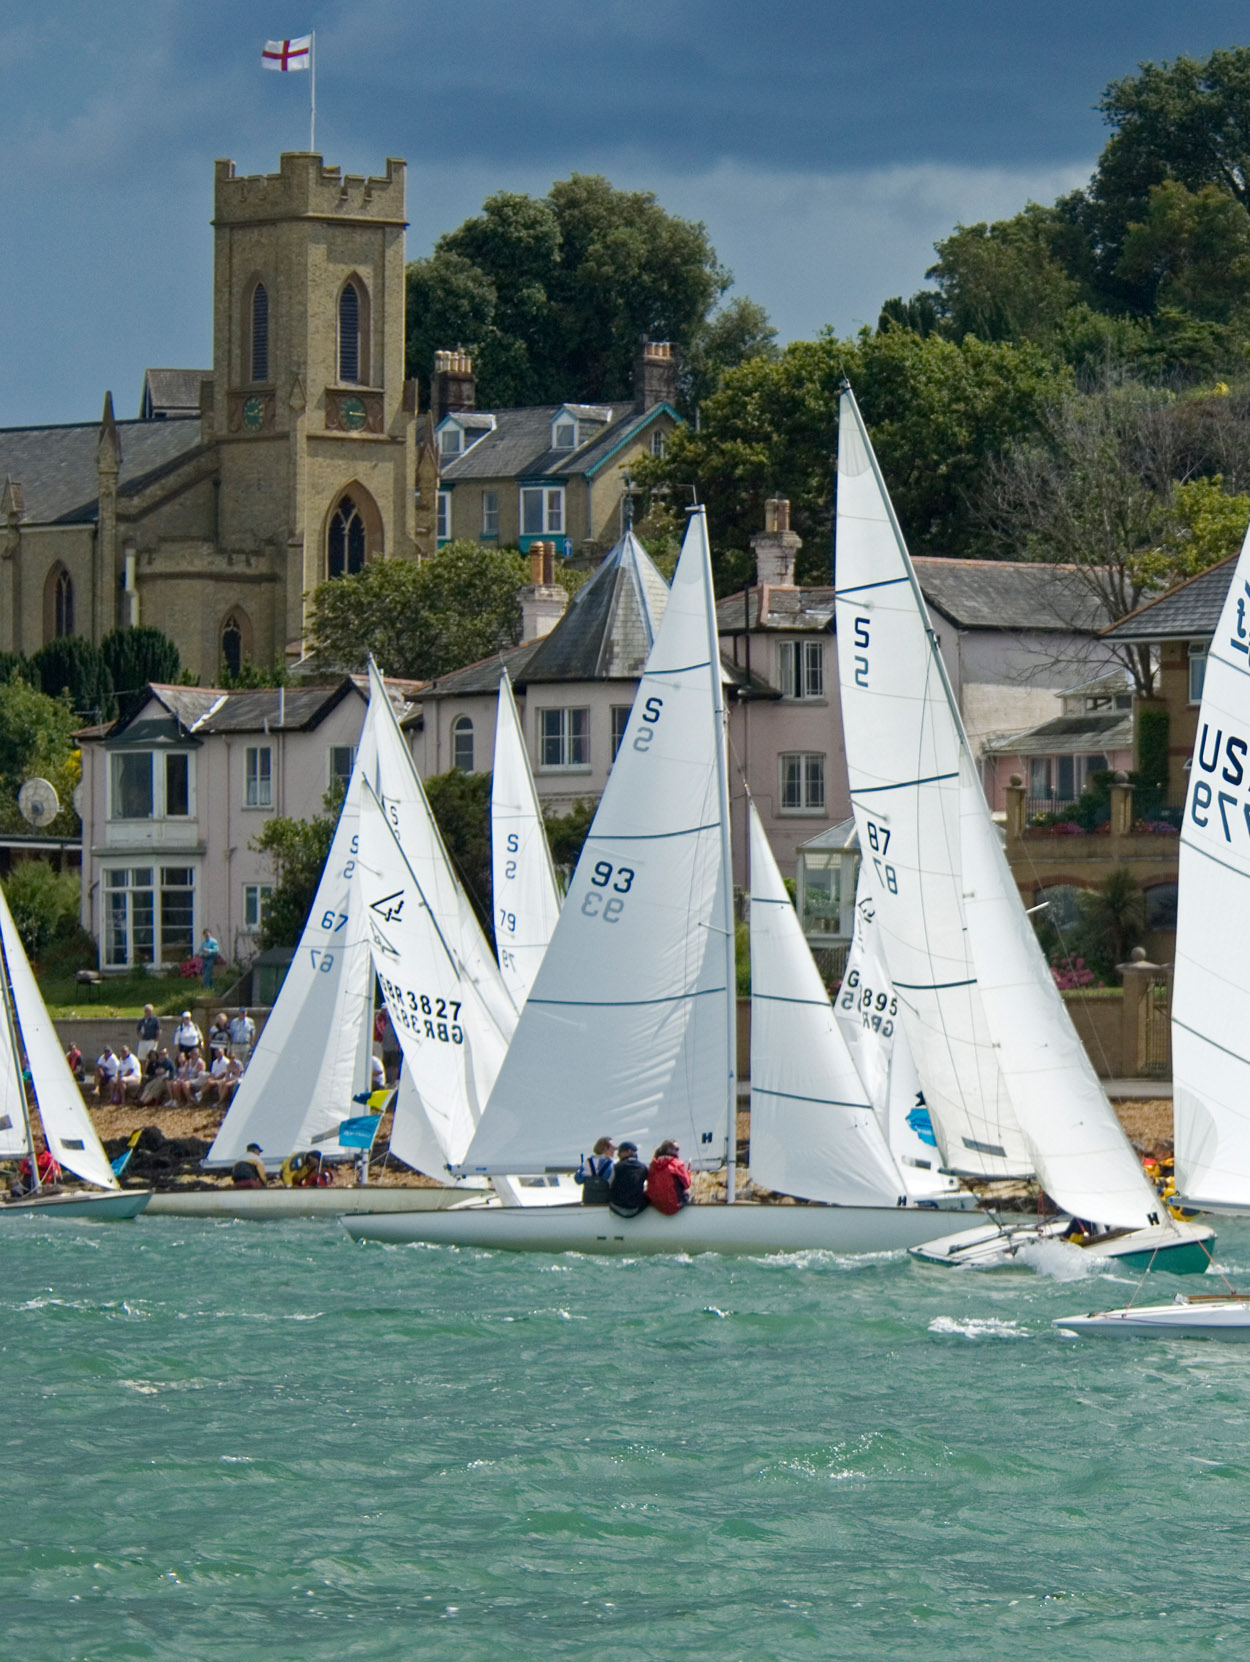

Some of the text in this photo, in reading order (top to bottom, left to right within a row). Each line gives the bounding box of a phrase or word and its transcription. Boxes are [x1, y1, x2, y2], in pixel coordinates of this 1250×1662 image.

[854, 617, 871, 649] S
[642, 697, 663, 723] S
[507, 833, 519, 853] S
[867, 821, 891, 855] 87
[591, 861, 635, 893] 93
[321, 910, 348, 933] 67
[500, 908, 517, 933] 79
